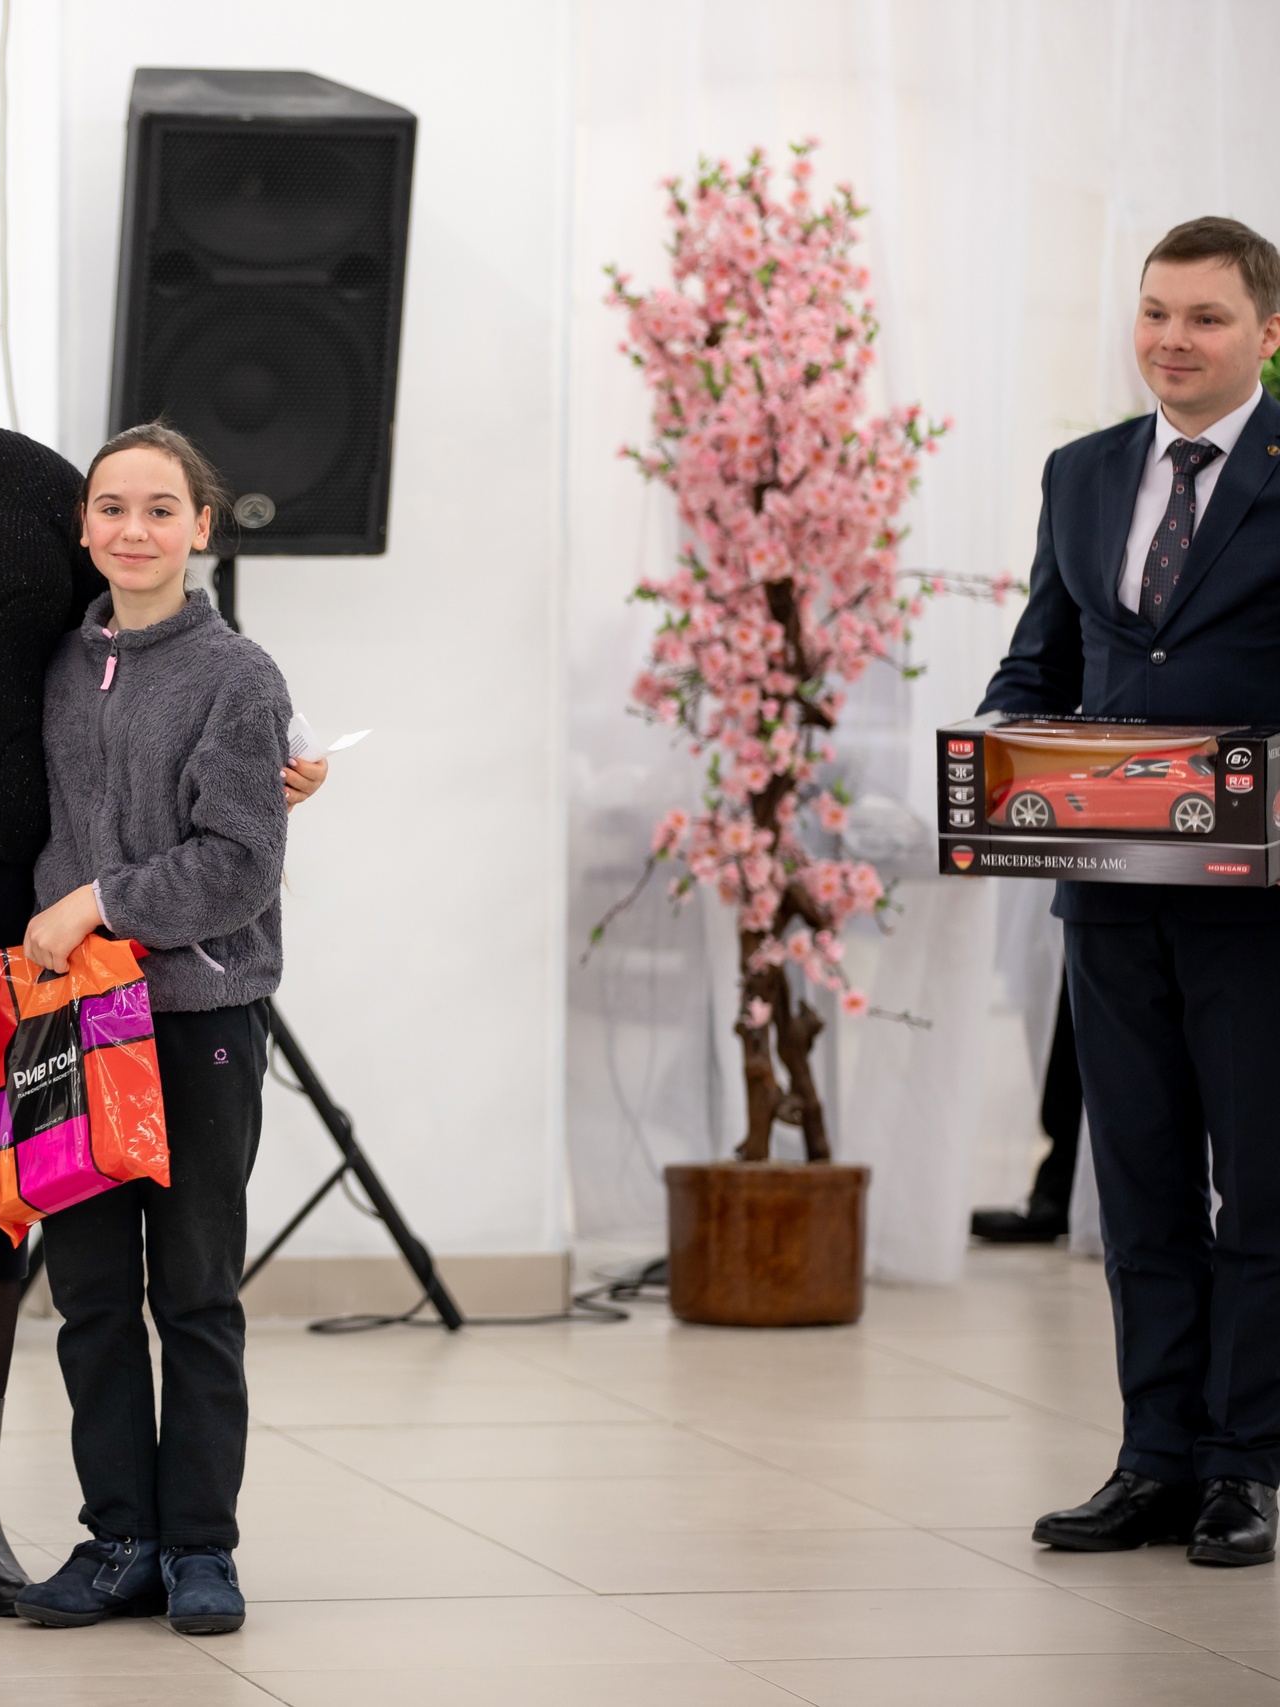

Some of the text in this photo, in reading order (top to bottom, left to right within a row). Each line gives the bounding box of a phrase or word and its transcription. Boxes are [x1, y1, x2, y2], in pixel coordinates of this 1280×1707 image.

[1229, 776, 1250, 786] R/C
[980, 853, 1127, 870] MERCEDES-BENZ SLS AMG
[13, 1062, 47, 1089] РИВ
